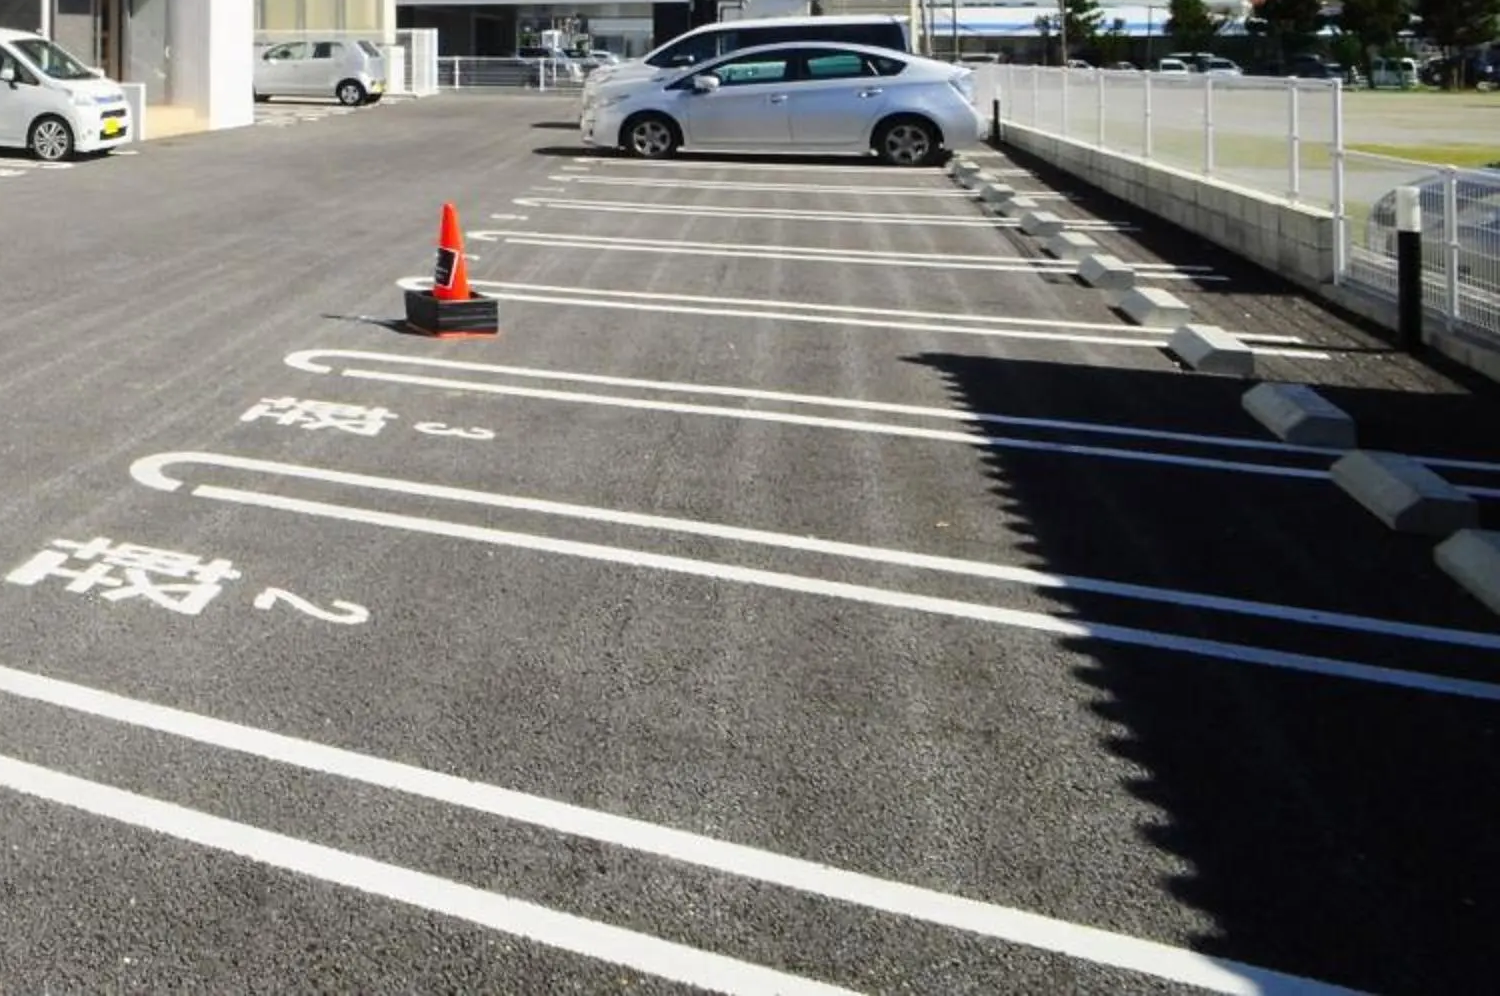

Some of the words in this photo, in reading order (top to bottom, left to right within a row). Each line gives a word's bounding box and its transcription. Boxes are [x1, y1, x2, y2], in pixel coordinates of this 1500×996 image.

[241, 397, 398, 436] 軽
[414, 422, 496, 441] 3
[5, 536, 242, 615] 軽
[254, 587, 370, 625] 2
